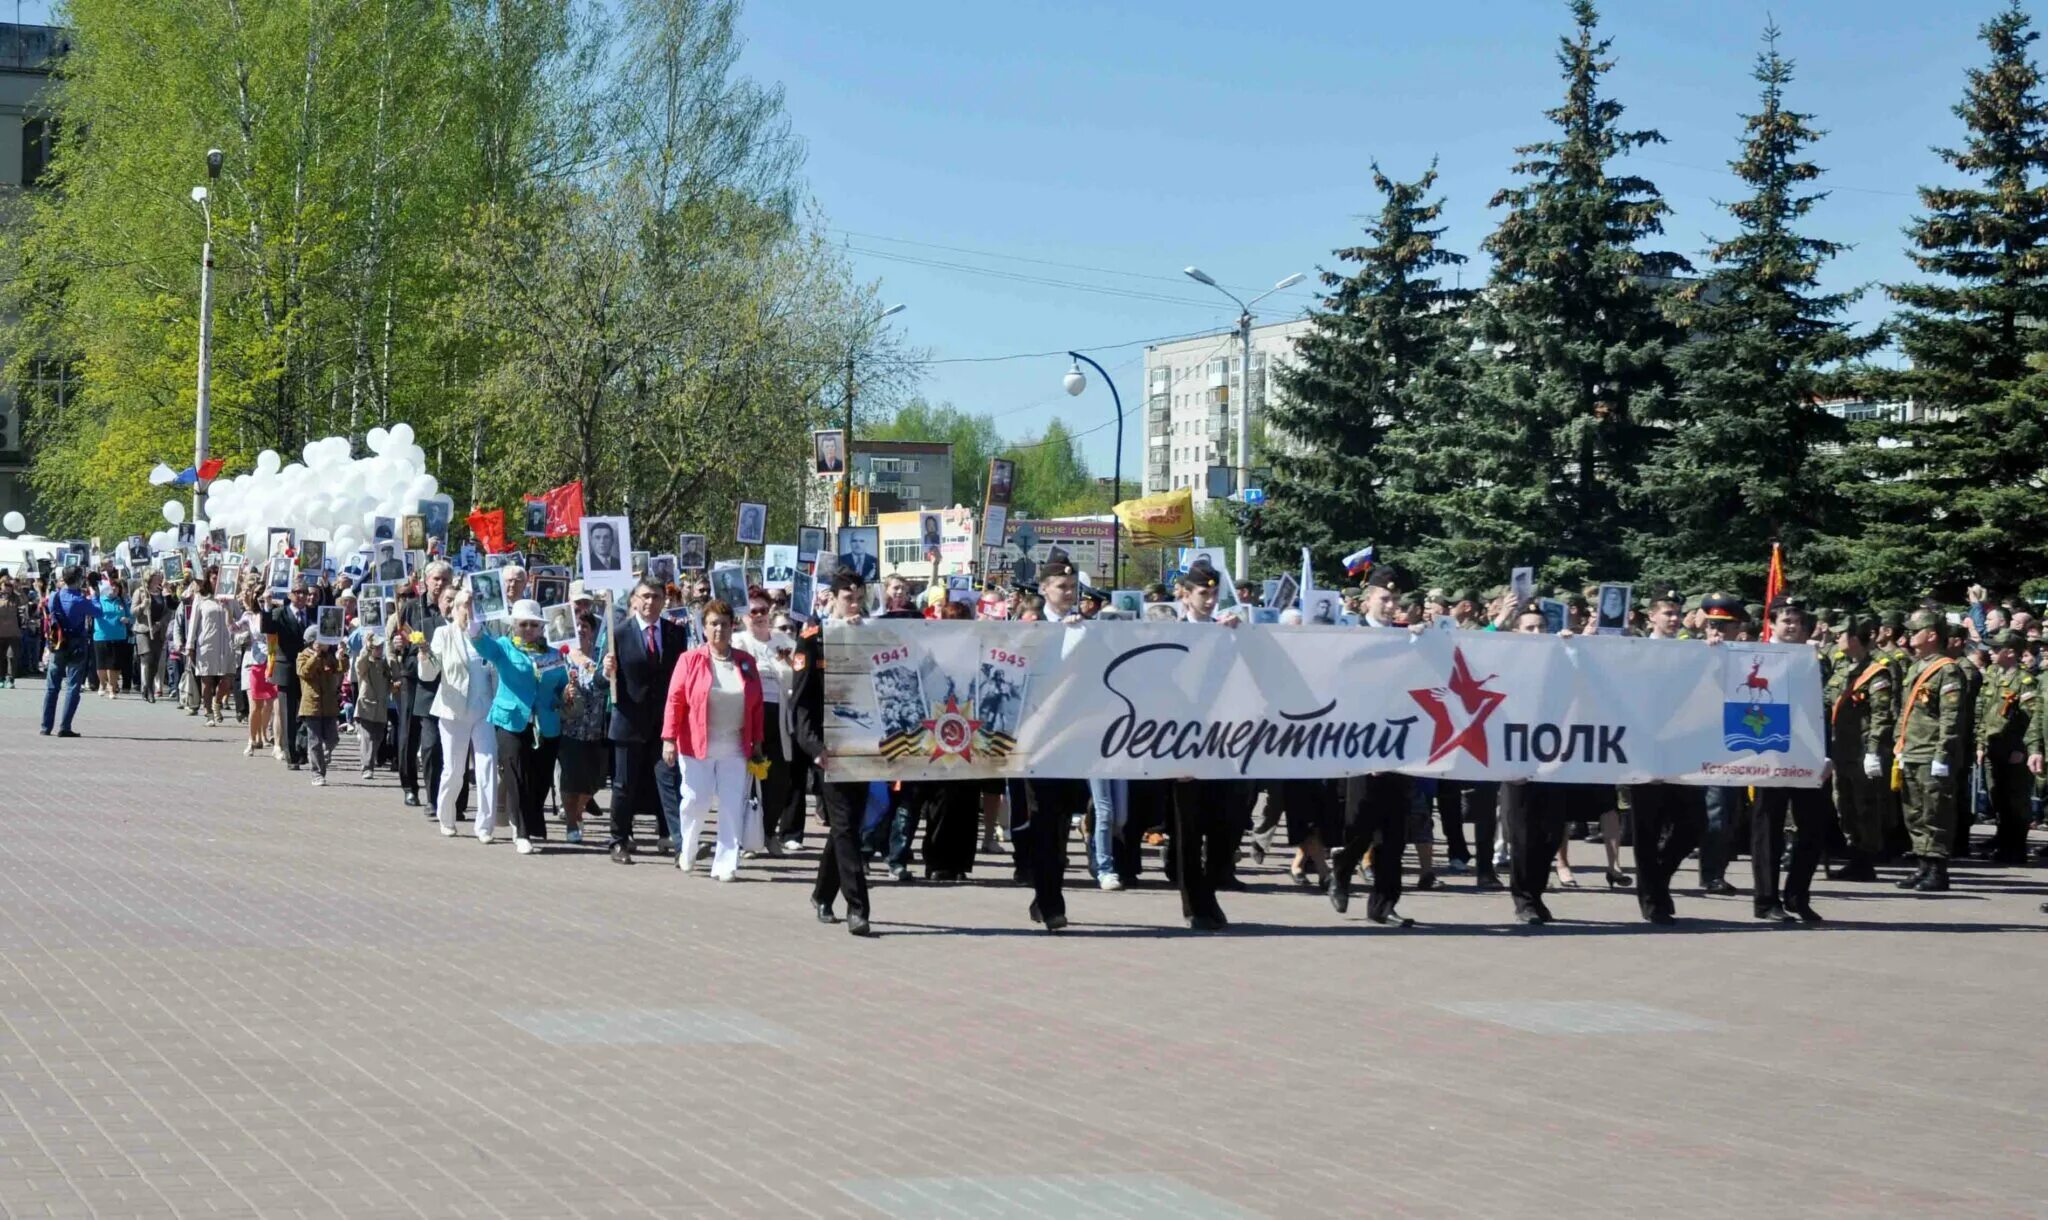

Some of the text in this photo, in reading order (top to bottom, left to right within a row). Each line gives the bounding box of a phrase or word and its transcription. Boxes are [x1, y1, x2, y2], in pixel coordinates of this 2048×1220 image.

[1071, 525, 1109, 536] цены
[871, 646, 909, 666] 1941
[990, 648, 1026, 668] 1945
[1701, 762, 1813, 778] Кстовский район
